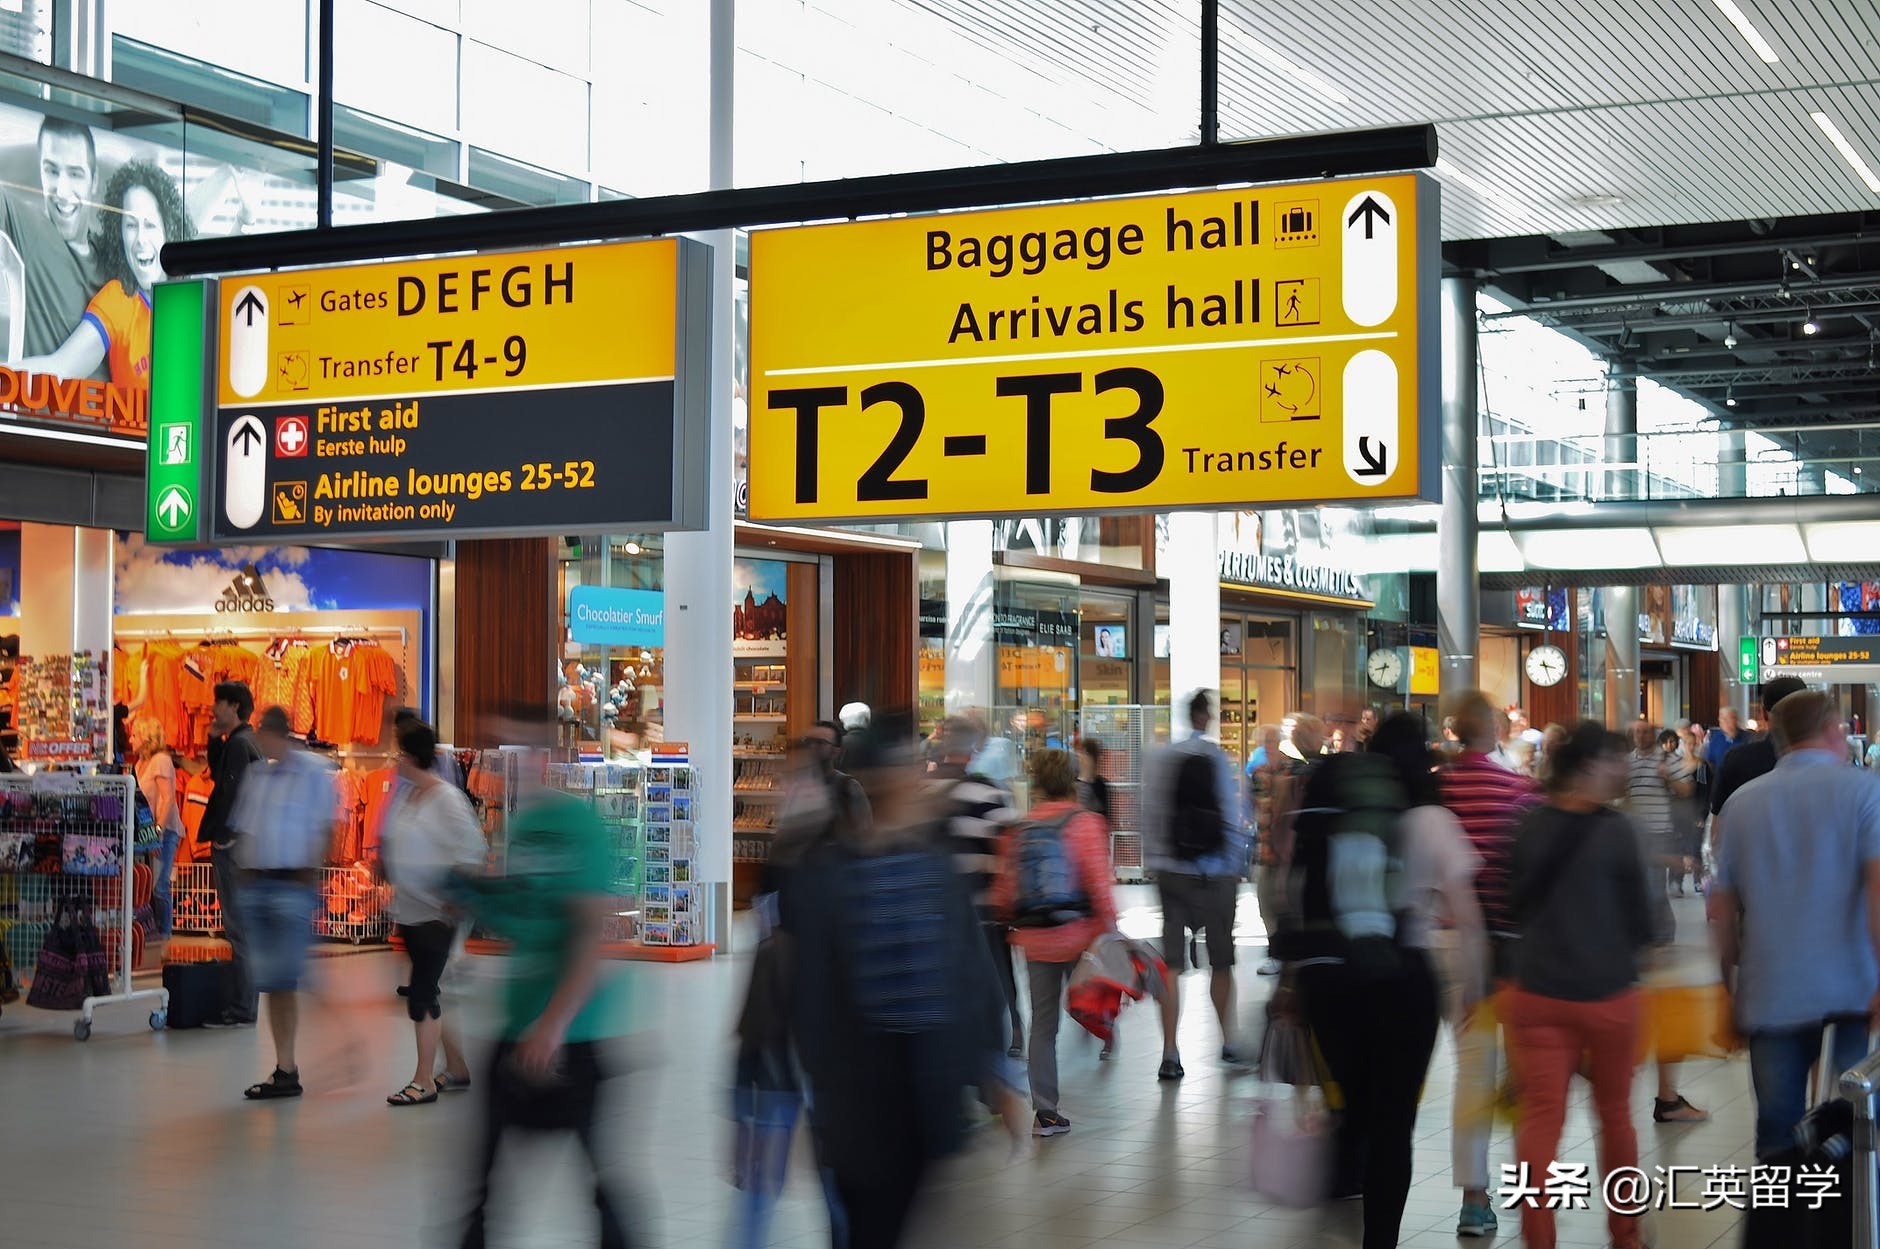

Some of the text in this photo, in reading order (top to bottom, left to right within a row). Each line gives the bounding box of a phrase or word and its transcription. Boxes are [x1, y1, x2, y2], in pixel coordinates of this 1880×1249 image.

[926, 200, 1260, 278] Baggage hall
[320, 289, 388, 312] Gates
[947, 278, 1260, 344] Arrivals hall
[318, 335, 527, 381] Transfer T4-9
[317, 401, 419, 433] First aid
[316, 434, 406, 457] Eerste hulp
[766, 366, 1167, 505] T2-T3
[1182, 441, 1322, 474] Transfer
[314, 460, 596, 501] Airline lounges 25-52
[314, 500, 456, 527] By invitation only
[1295, 563, 1358, 594] COSMETICS
[215, 596, 274, 612] adidas
[577, 603, 633, 624] Chocolatier
[1039, 622, 1055, 634] ELIE
[1055, 624, 1073, 636] SAAB
[1789, 637, 1820, 645] First aid
[1789, 652, 1815, 660] Airline
[1816, 651, 1847, 661] lounges
[1096, 663, 1123, 676] Skin
[48, 741, 90, 755] OFFER
